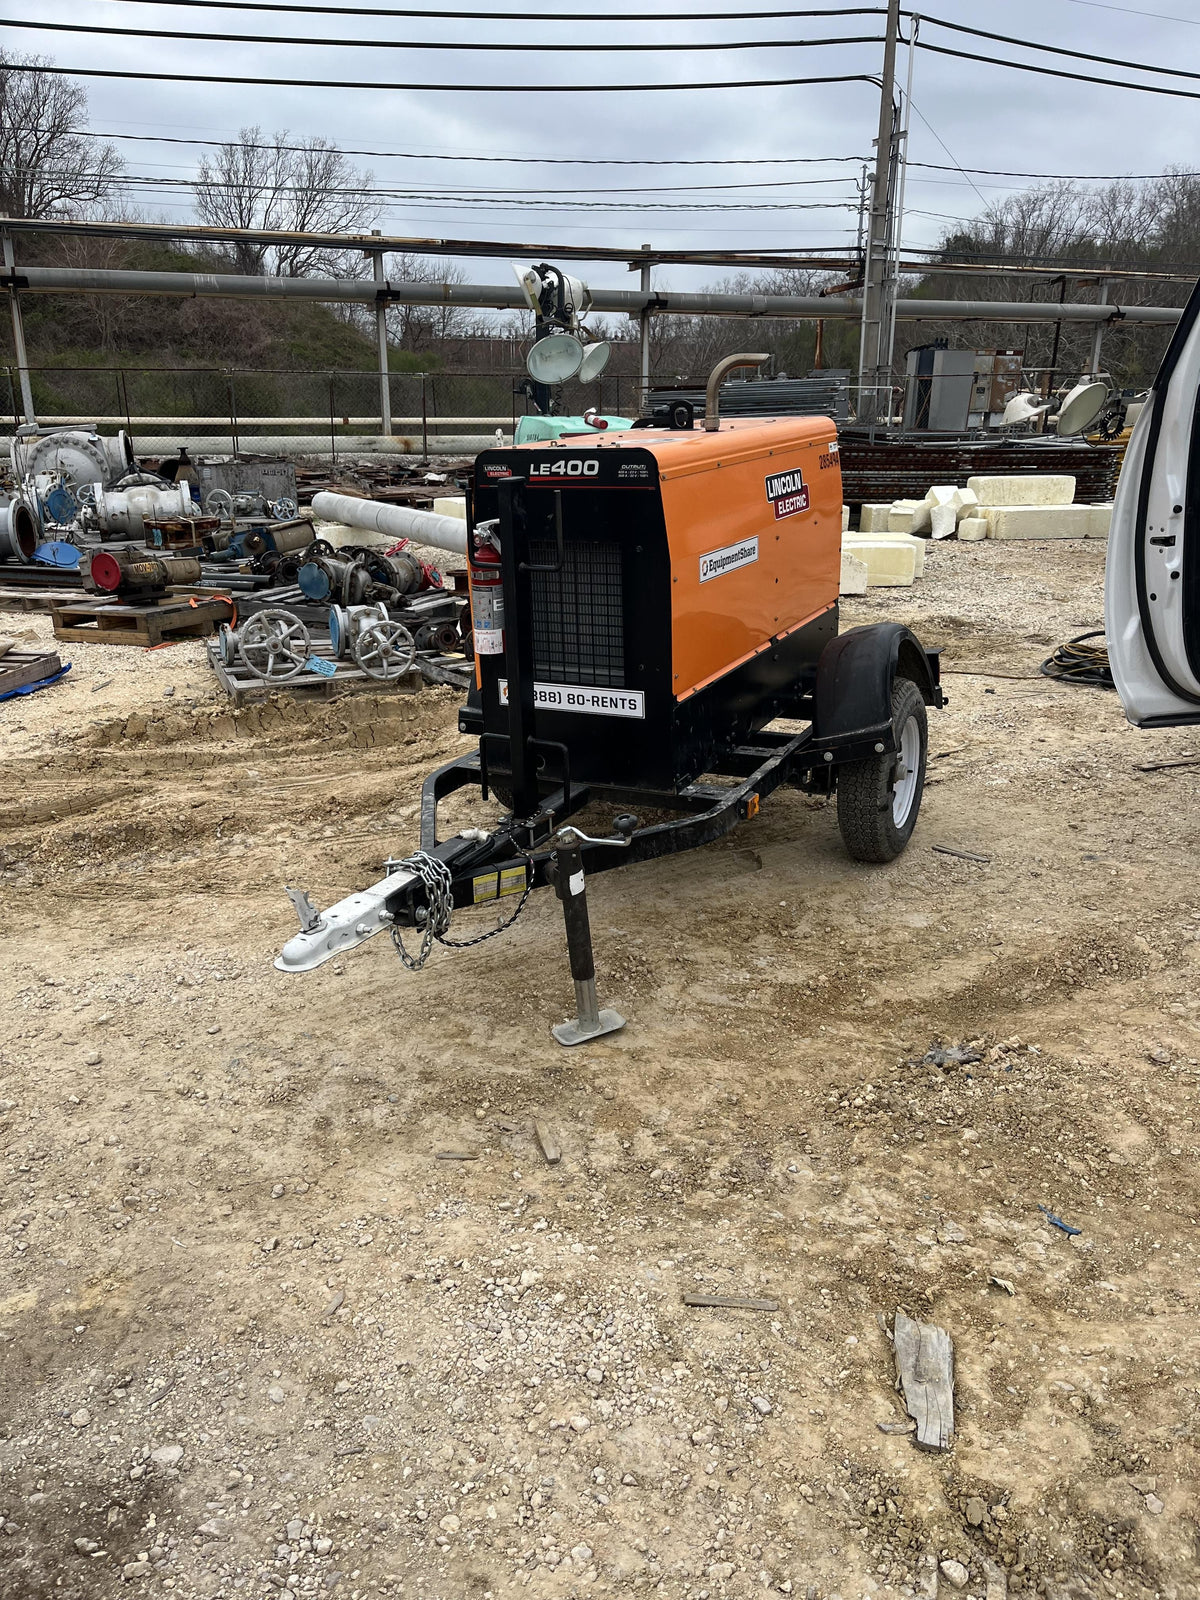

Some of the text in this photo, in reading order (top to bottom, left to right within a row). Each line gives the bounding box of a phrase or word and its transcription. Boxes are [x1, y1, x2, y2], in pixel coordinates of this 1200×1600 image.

[529, 460, 600, 475] LE400
[767, 472, 802, 499] LINCOLN
[778, 493, 807, 515] ELECTRIC
[708, 546, 756, 573] EquipmentShare
[567, 693, 637, 711] 80-RENTS
